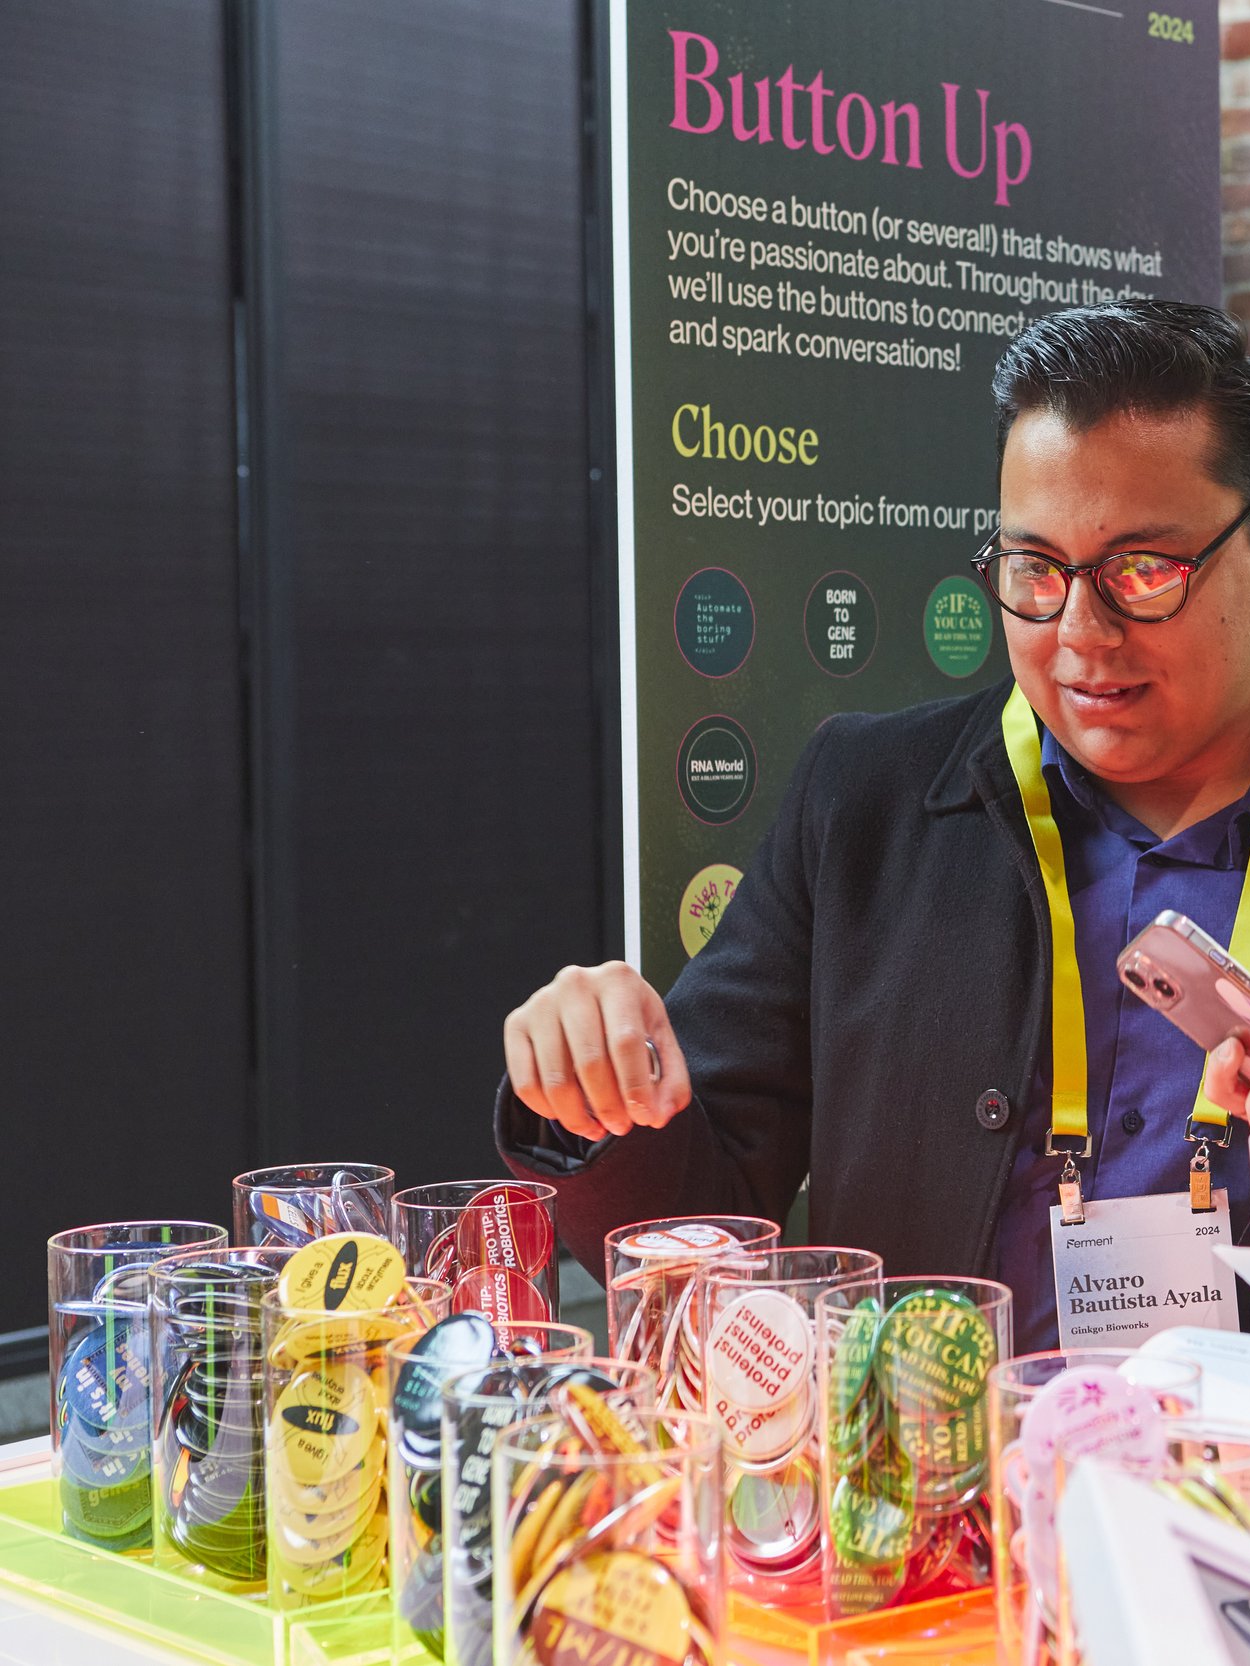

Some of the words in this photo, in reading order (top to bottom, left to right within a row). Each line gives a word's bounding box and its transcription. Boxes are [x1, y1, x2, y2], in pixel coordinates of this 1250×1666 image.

[1148, 13, 1195, 44] 2024
[667, 29, 923, 169] Button
[941, 82, 1032, 207] Up
[667, 177, 768, 222] Choose
[771, 200, 787, 225] a
[791, 195, 867, 236] button
[872, 206, 903, 242] (or
[907, 218, 997, 257] several!)
[1002, 227, 1042, 261] that
[1046, 235, 1111, 270] shows
[1114, 247, 1162, 277] what
[667, 228, 745, 263] you’re
[751, 241, 879, 279] passionate
[883, 253, 952, 288] about.
[956, 261, 1079, 305] Throughout
[1082, 280, 1114, 306] the
[668, 271, 722, 304] we’ll
[728, 282, 772, 309] use
[777, 281, 816, 314] the
[821, 285, 907, 325] buttons
[911, 298, 933, 327] to
[937, 310, 1025, 337] connect
[669, 316, 717, 347] and
[722, 323, 792, 356] spark
[796, 332, 961, 372] conversations!
[671, 403, 819, 465] Choose
[671, 483, 753, 519] Select
[757, 495, 812, 526] your
[816, 493, 874, 530] topic
[878, 496, 930, 527] from
[933, 507, 969, 529] our
[696, 604, 742, 613] Automate
[826, 589, 856, 604] BORN
[950, 593, 968, 613] IF
[697, 614, 713, 623] the
[833, 608, 850, 623] TO
[934, 616, 957, 629] YOU
[960, 616, 983, 629] CAN
[697, 625, 731, 635] boring
[697, 635, 725, 644] stuff
[827, 626, 856, 641] GENE
[829, 644, 854, 659] EDIT
[690, 760, 713, 773] RNA
[715, 759, 744, 772] World
[689, 881, 718, 918] High
[481, 1211, 496, 1238] TIP:
[493, 1194, 516, 1268] ROBIOTICS
[1066, 1236, 1114, 1249] Ferment
[1195, 1226, 1220, 1236] 2024
[485, 1238, 500, 1266] PRO
[300, 1268, 318, 1290] give
[329, 1261, 354, 1290] flux
[355, 1268, 373, 1291] about
[367, 1257, 393, 1292] enzymes
[1068, 1273, 1145, 1295] Alvaro
[1070, 1293, 1158, 1314] Bautista
[1163, 1285, 1222, 1308] Ayala
[930, 1301, 966, 1341] IF
[1071, 1323, 1104, 1335] Ginkgo
[1106, 1320, 1149, 1333] Bioworks
[736, 1306, 803, 1365] proteins!
[724, 1321, 791, 1382] proteins!
[895, 1319, 942, 1356] YOU
[941, 1343, 991, 1382] CAN
[75, 1367, 95, 1392] in
[714, 1336, 780, 1397] proteins!
[306, 1409, 335, 1431] flux
[933, 1425, 951, 1463] YO
[102, 1457, 126, 1478] in
